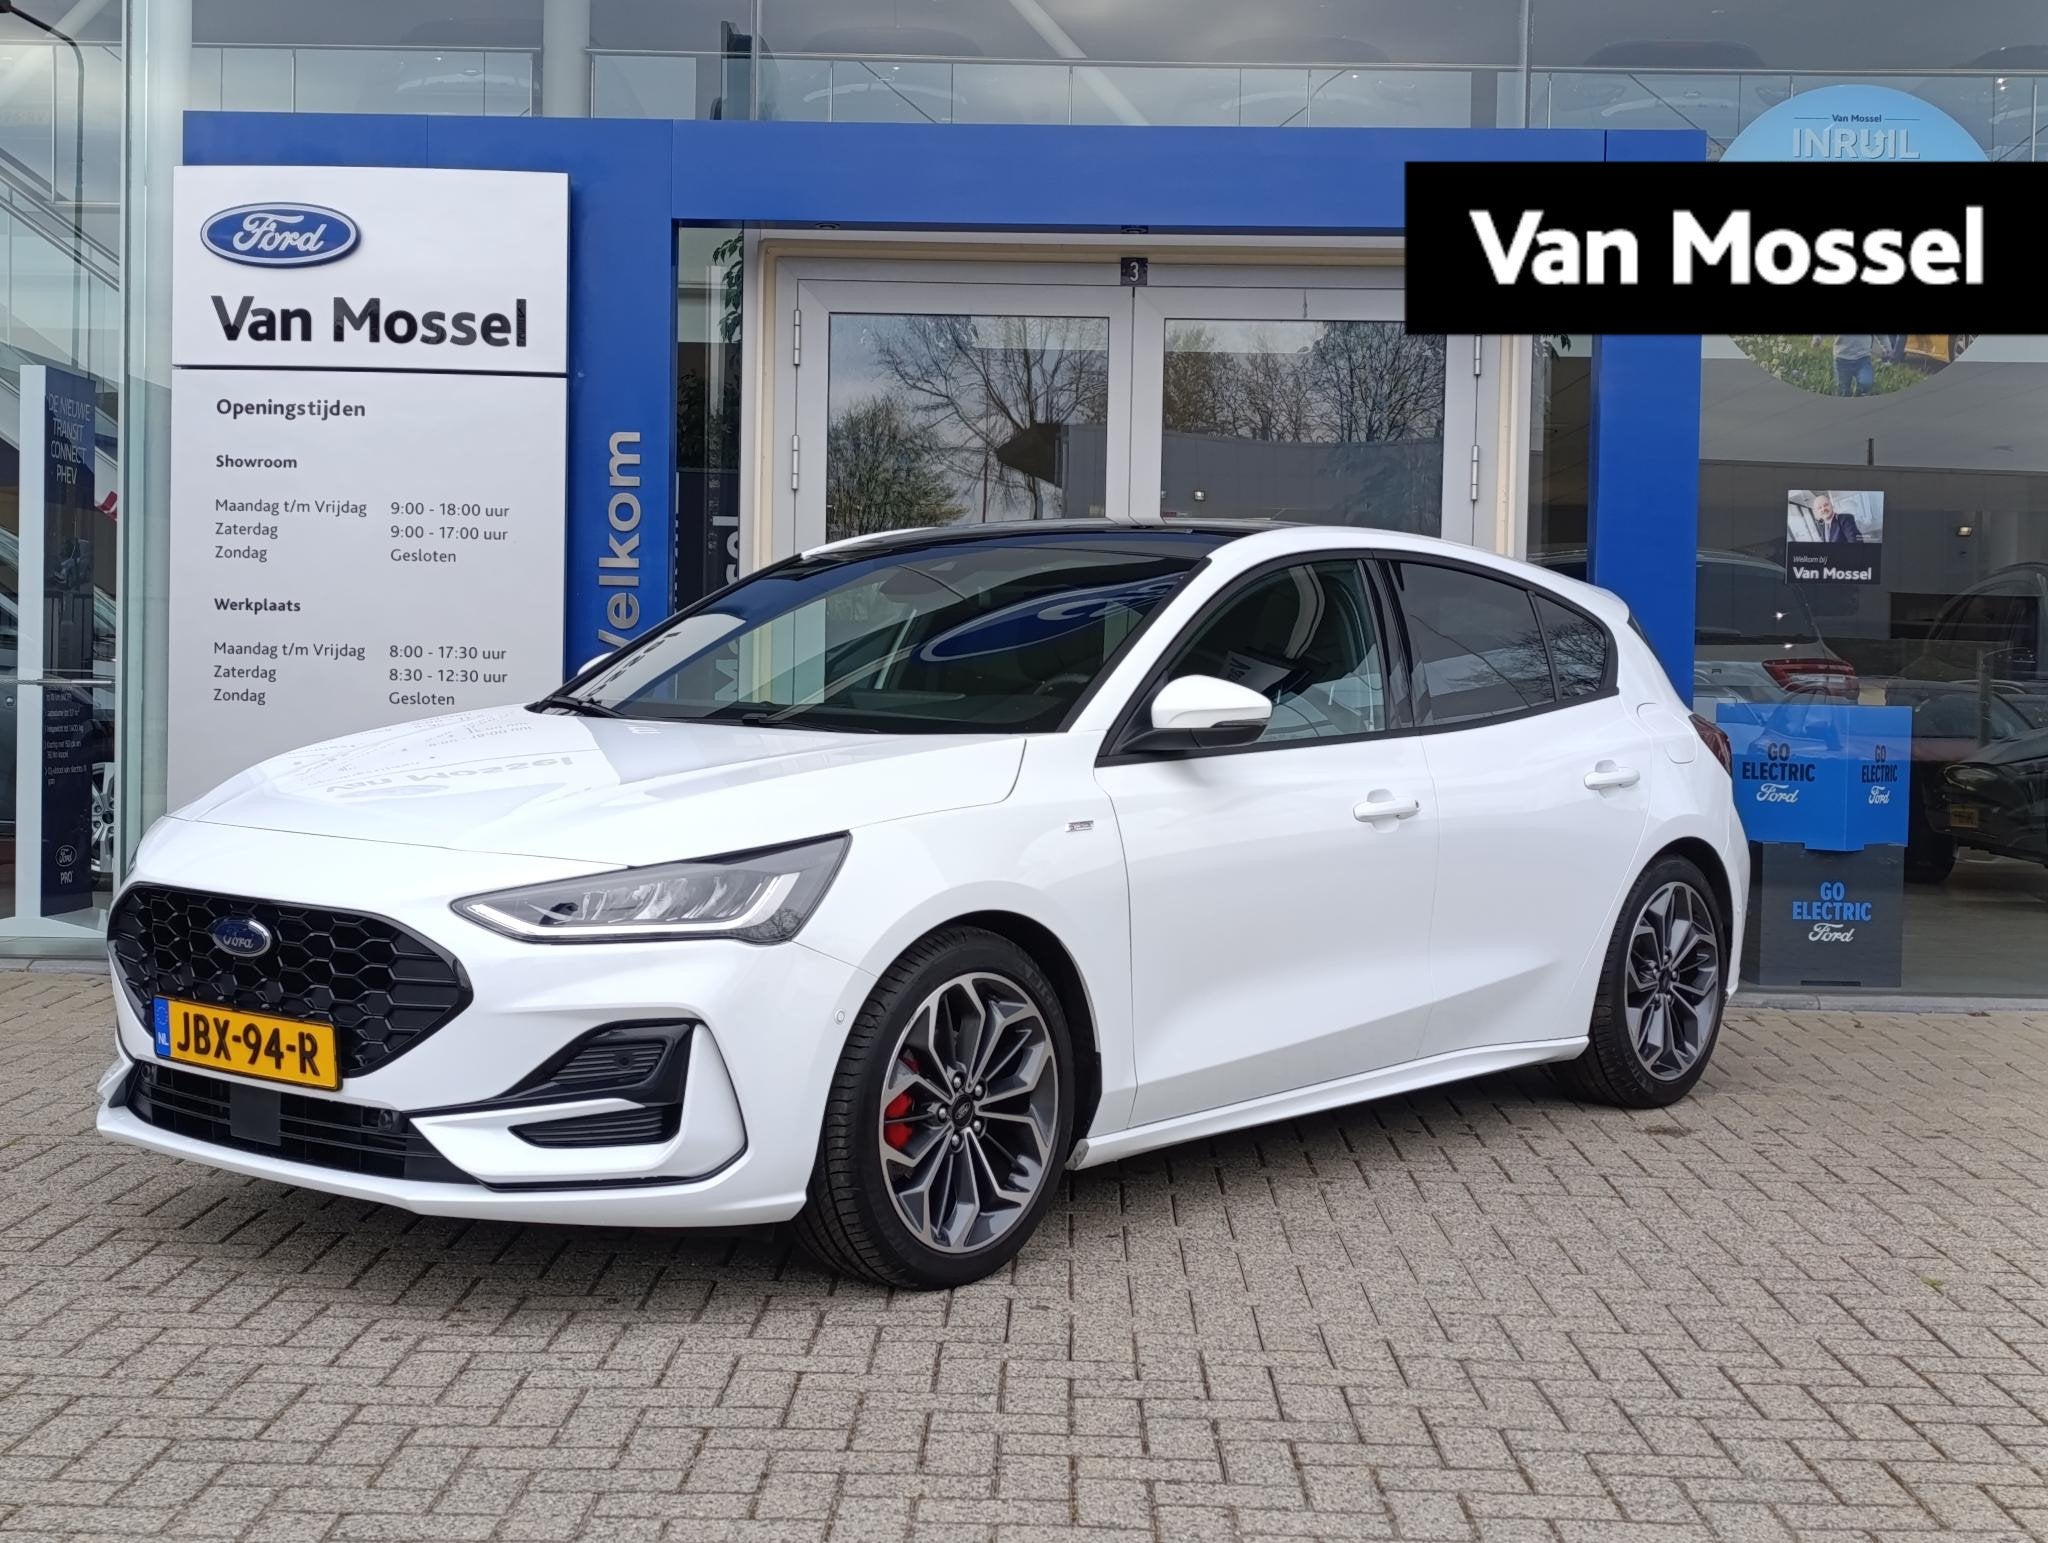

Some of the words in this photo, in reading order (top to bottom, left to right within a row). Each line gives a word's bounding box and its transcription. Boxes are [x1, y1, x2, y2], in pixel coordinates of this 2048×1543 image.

[1831, 114, 1849, 122] Van
[1851, 114, 1882, 123] Mossel
[1793, 128, 1920, 159] INRUIL
[232, 212, 328, 253] Ford
[1130, 261, 1139, 282] 3
[211, 295, 313, 342] Van
[333, 297, 527, 347] Mossel
[48, 392, 59, 413] DE
[60, 397, 91, 421] NIEUWE
[216, 399, 366, 420] Openingstijden
[53, 417, 84, 441] TRANSIT
[50, 440, 87, 464] CONNECT
[216, 455, 298, 469] Showroom
[56, 463, 78, 484] PHEV
[215, 499, 279, 516] Maandag
[284, 499, 310, 514] t/m
[315, 500, 367, 518] Vrijdag
[391, 502, 424, 516] 9:00
[439, 503, 481, 517] 18:00
[485, 506, 509, 517] uur
[215, 522, 278, 539] Zaterdag
[391, 526, 424, 539] 9:00
[439, 527, 479, 540] 17:00
[484, 530, 508, 541] uur
[215, 546, 268, 563] Zondag
[390, 549, 456, 563] Gesloten
[1793, 567, 1819, 579] Van
[1823, 567, 1872, 580] Mossel
[214, 598, 301, 615] Werkplaats
[213, 642, 278, 659] Maandag
[282, 643, 309, 656] t/m
[313, 643, 366, 661] Vrijdag
[389, 645, 423, 658] 8:00
[437, 646, 478, 659] 17:30
[482, 648, 507, 660] uur
[213, 665, 277, 682] Zaterdag
[389, 669, 422, 682] 8:30
[437, 669, 478, 683] 12:30
[483, 672, 508, 683] uur
[213, 688, 266, 706] Zondag
[389, 692, 455, 706] Gesloten
[1767, 743, 1790, 761] GO
[1875, 745, 1886, 763] GO
[1742, 761, 1816, 782] ELECTRIC
[1861, 764, 1898, 783] ELECTRIC
[1756, 783, 1800, 803] Ford
[1868, 785, 1891, 805] Ford
[60, 870, 73, 885] PRO
[1820, 881, 1845, 901] GO
[1792, 901, 1872, 921] ELECTRIC
[1808, 922, 1856, 942] Ford
[157, 1032, 169, 1046] NL
[177, 1012, 320, 1077] JBX-94-R
